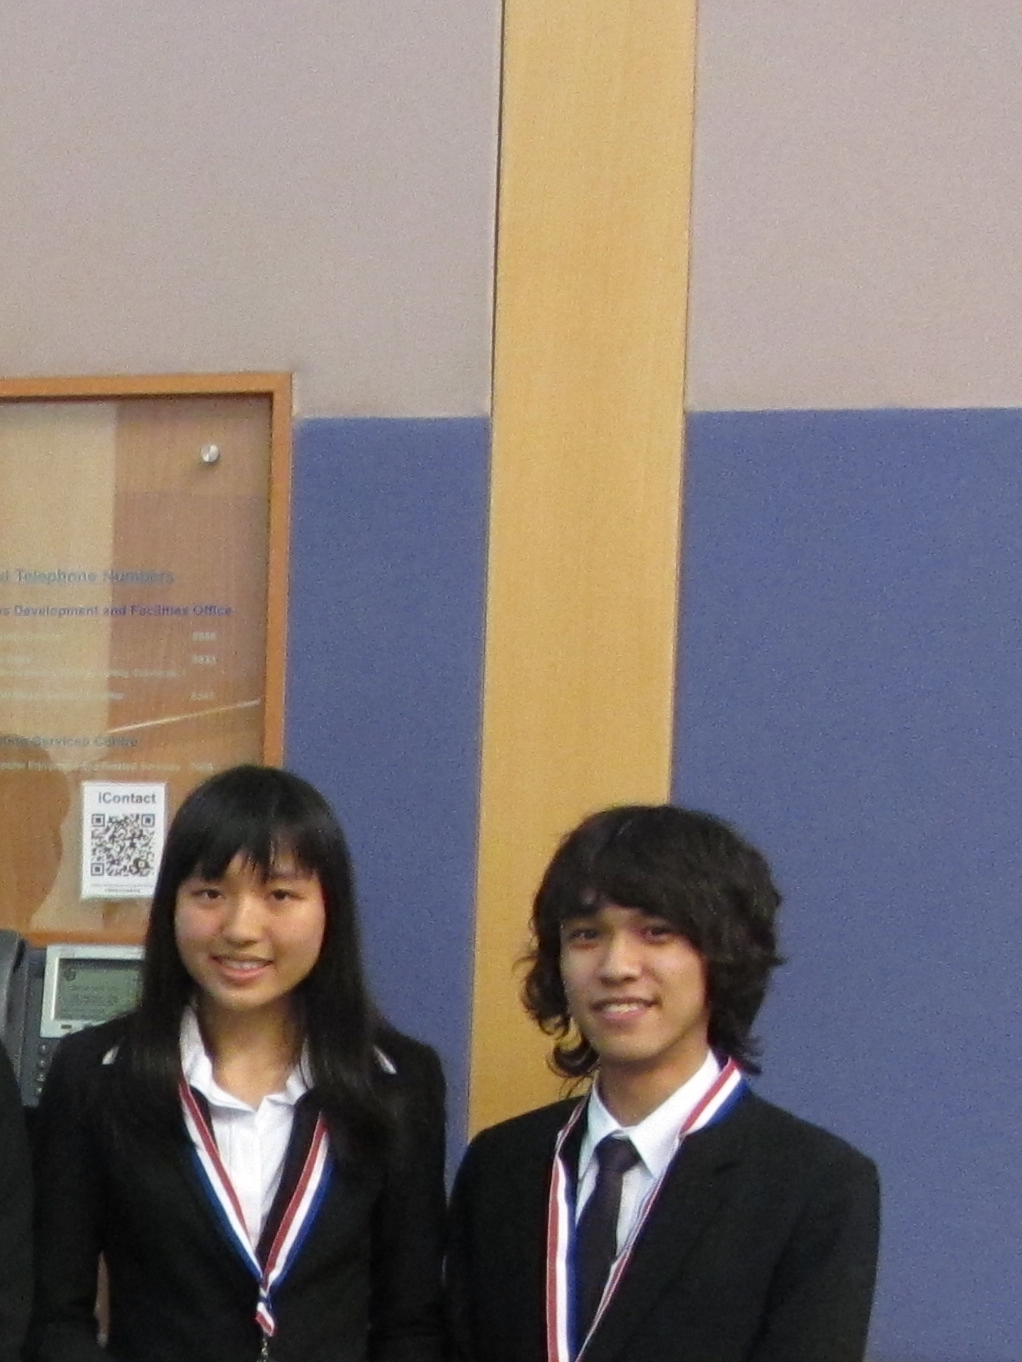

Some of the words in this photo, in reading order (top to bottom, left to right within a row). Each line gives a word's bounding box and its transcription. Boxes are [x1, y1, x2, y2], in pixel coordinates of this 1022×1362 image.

[16, 569, 96, 585] Telephone
[104, 570, 174, 582] Numbers
[14, 605, 97, 618] Development
[103, 605, 126, 616] and
[131, 605, 188, 616] Facilities
[193, 604, 232, 616] Office
